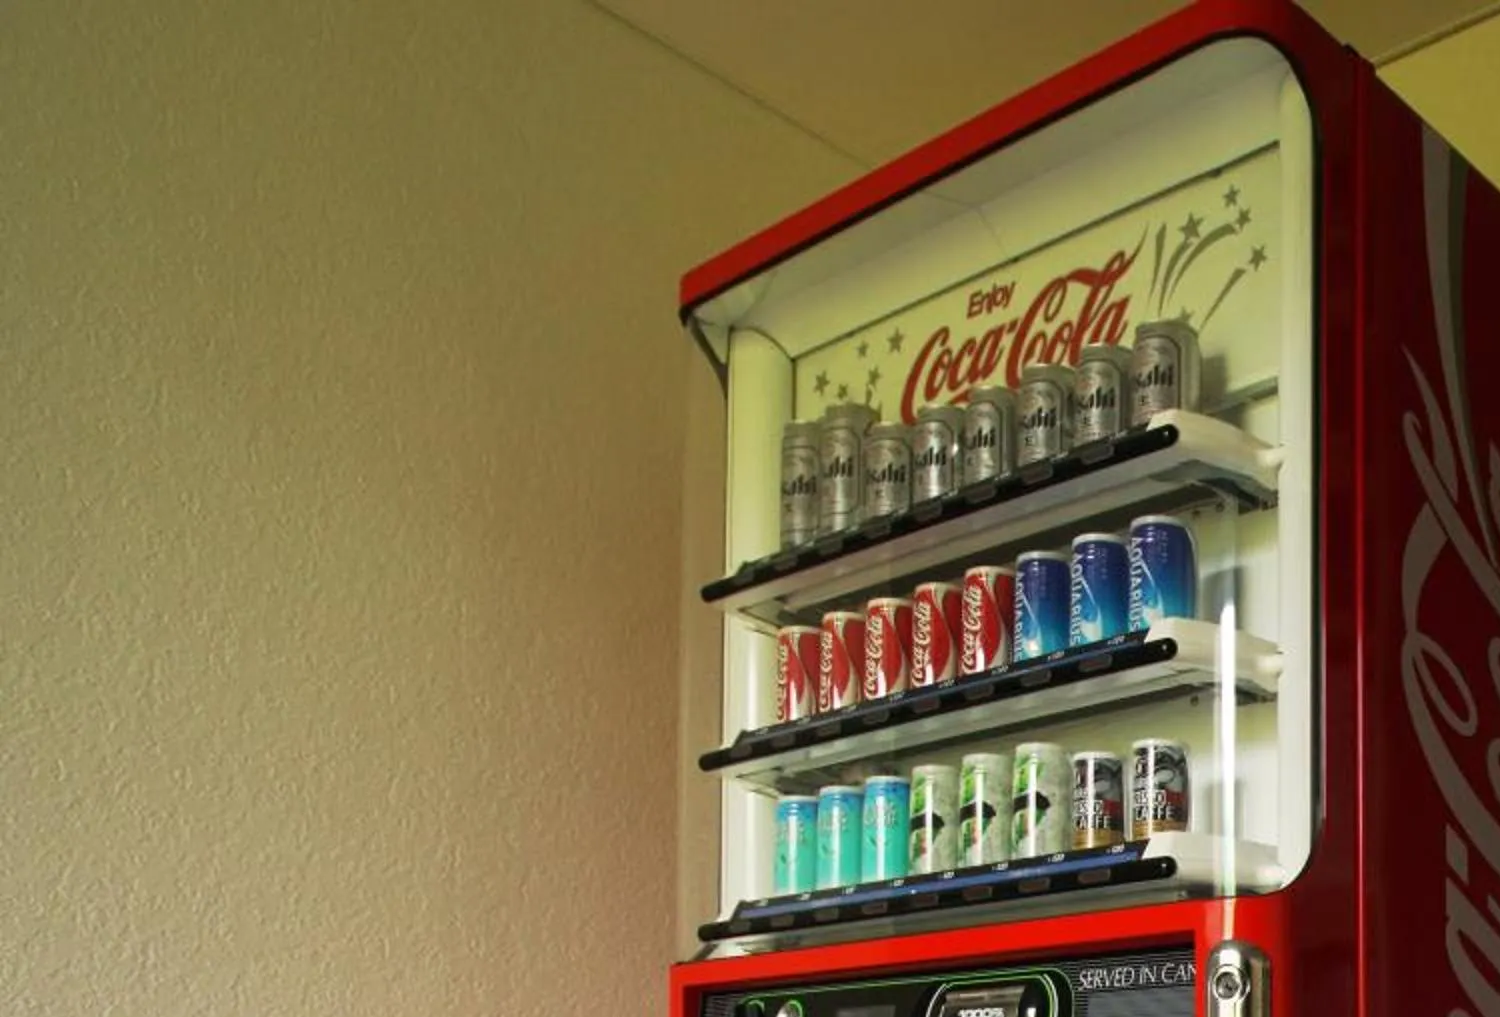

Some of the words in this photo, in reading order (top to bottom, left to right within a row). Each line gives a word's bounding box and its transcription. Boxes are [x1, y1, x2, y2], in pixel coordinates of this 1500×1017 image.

[966, 280, 1016, 320] Enjoy
[901, 240, 1140, 425] Coca-Cola
[1134, 364, 1174, 388] sahi
[1129, 536, 1142, 633] AQUARIUS
[1078, 966, 1135, 992] SERVED
[1140, 964, 1158, 985] IN
